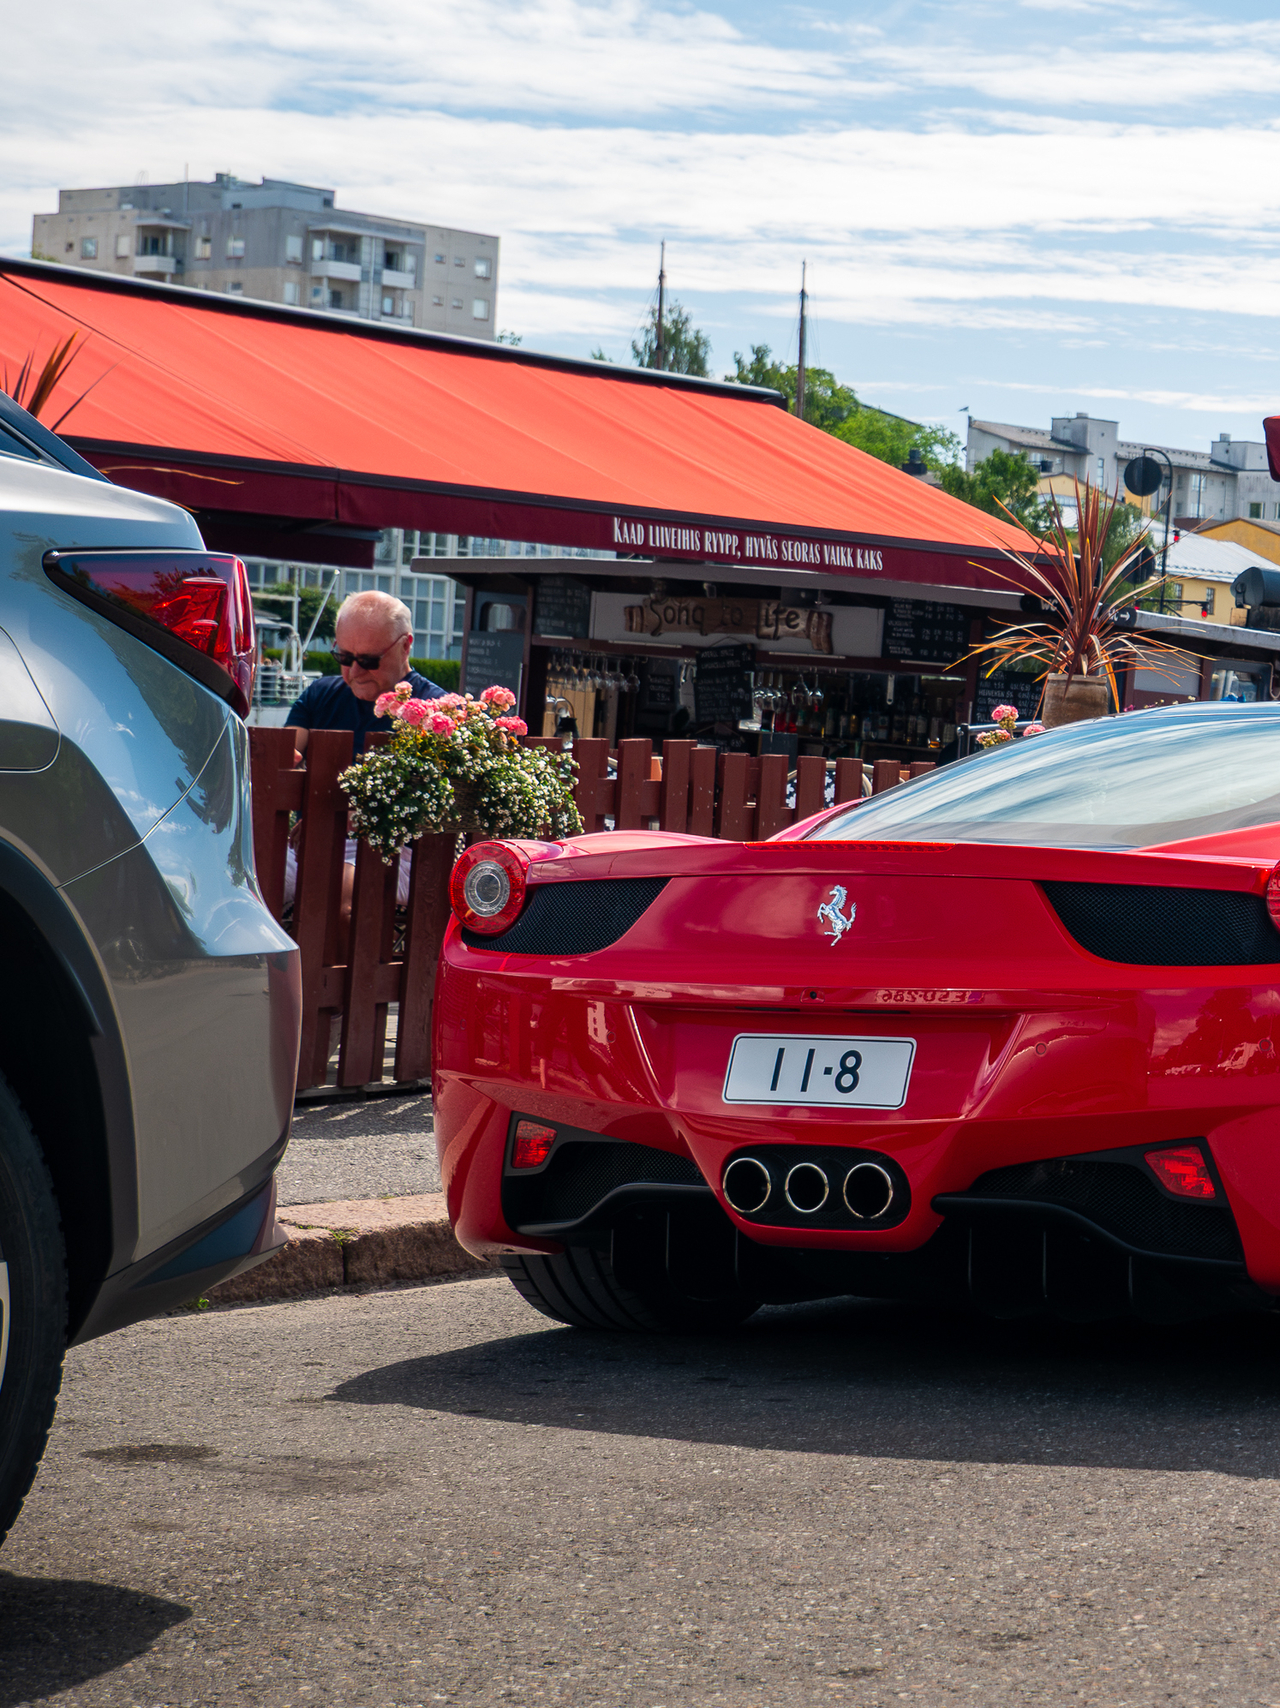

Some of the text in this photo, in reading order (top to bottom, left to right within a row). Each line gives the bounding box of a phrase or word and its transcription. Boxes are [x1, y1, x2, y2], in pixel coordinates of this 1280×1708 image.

[613, 516, 884, 571] KAAD LIIVEIHIS RYYPP, HYVÄS SEORAS VAIKK KAKS
[756, 602, 801, 641] Life
[1040, 598, 1059, 612] WC
[770, 1047, 863, 1094] 11-8
